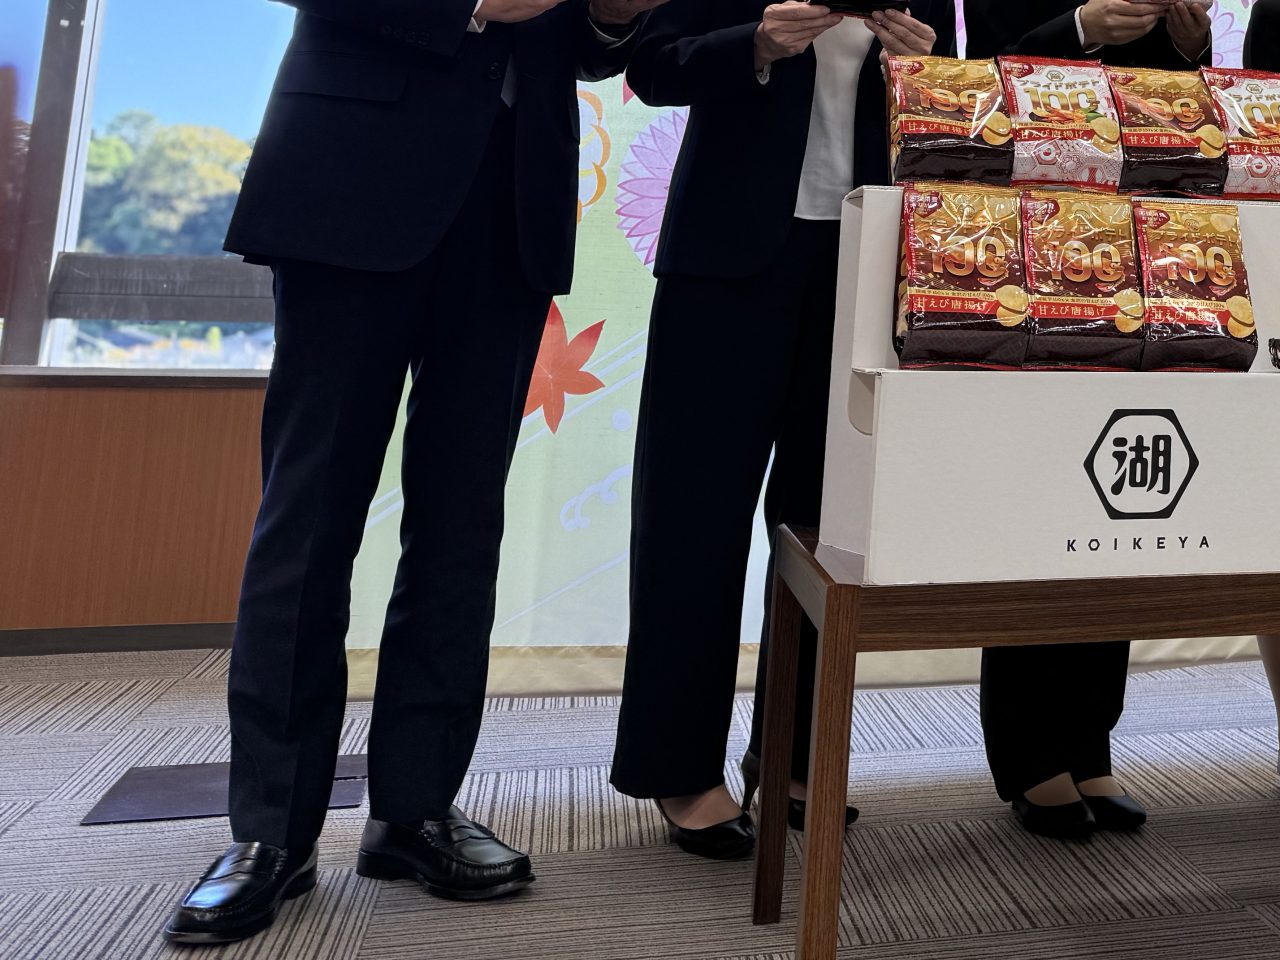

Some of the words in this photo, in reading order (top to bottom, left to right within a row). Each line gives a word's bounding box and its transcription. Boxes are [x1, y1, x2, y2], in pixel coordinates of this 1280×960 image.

[1038, 305, 1107, 316] 甘えび唐揚げ
[1111, 435, 1171, 495] 湖
[1067, 536, 1207, 552] KOIKEYA
